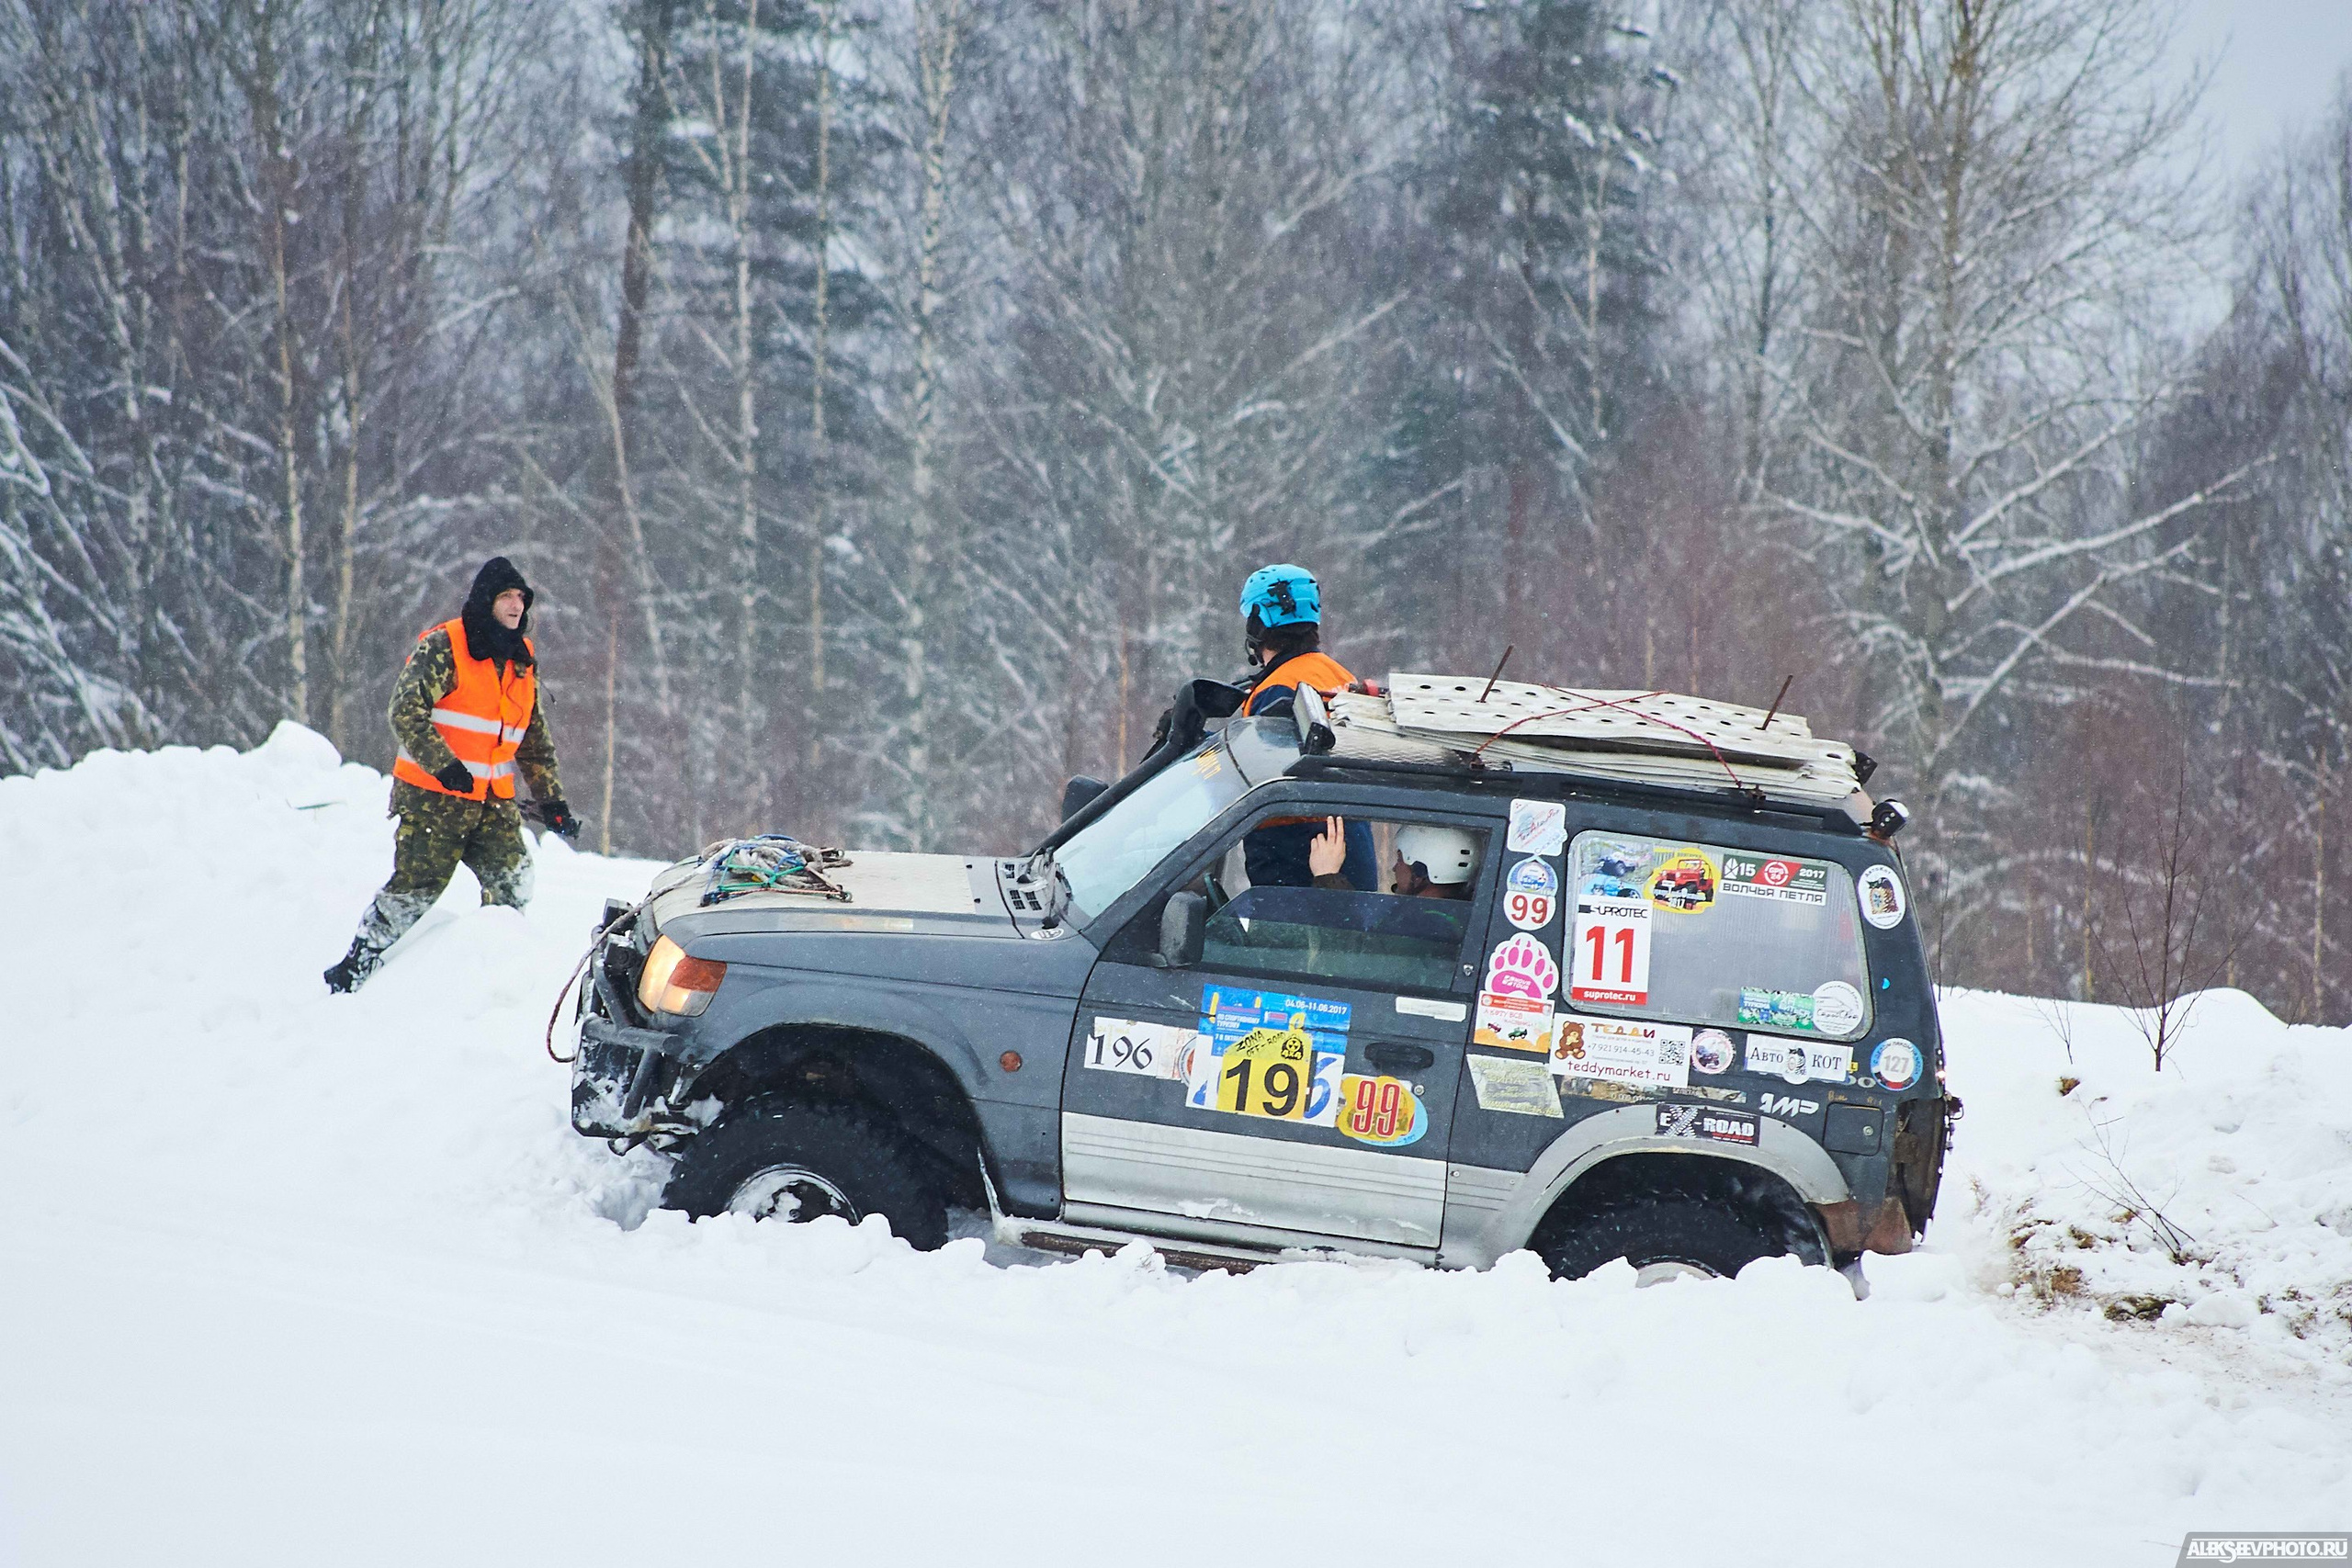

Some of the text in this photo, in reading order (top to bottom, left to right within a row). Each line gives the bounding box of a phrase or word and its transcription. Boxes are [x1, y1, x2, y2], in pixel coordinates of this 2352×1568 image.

[1739, 863, 1756, 876] 15
[1799, 868, 1825, 879] 2017
[1723, 883, 1823, 903] ВОЛЧЬЯ ПЕТЛЯ
[1511, 895, 1547, 923] 99
[1590, 905, 1647, 919] SUPROTEC
[1587, 926, 1634, 983] 11
[1584, 990, 1635, 1001] suprotec.ru
[1091, 1033, 1153, 1070] 196
[1236, 1031, 1265, 1052] ZONA
[1567, 1060, 1671, 1081] teddymarket.ru
[1812, 1054, 1842, 1070] КОТ
[1883, 1055, 1910, 1074] 127
[1226, 1058, 1299, 1116] 19
[1352, 1079, 1400, 1136] 99
